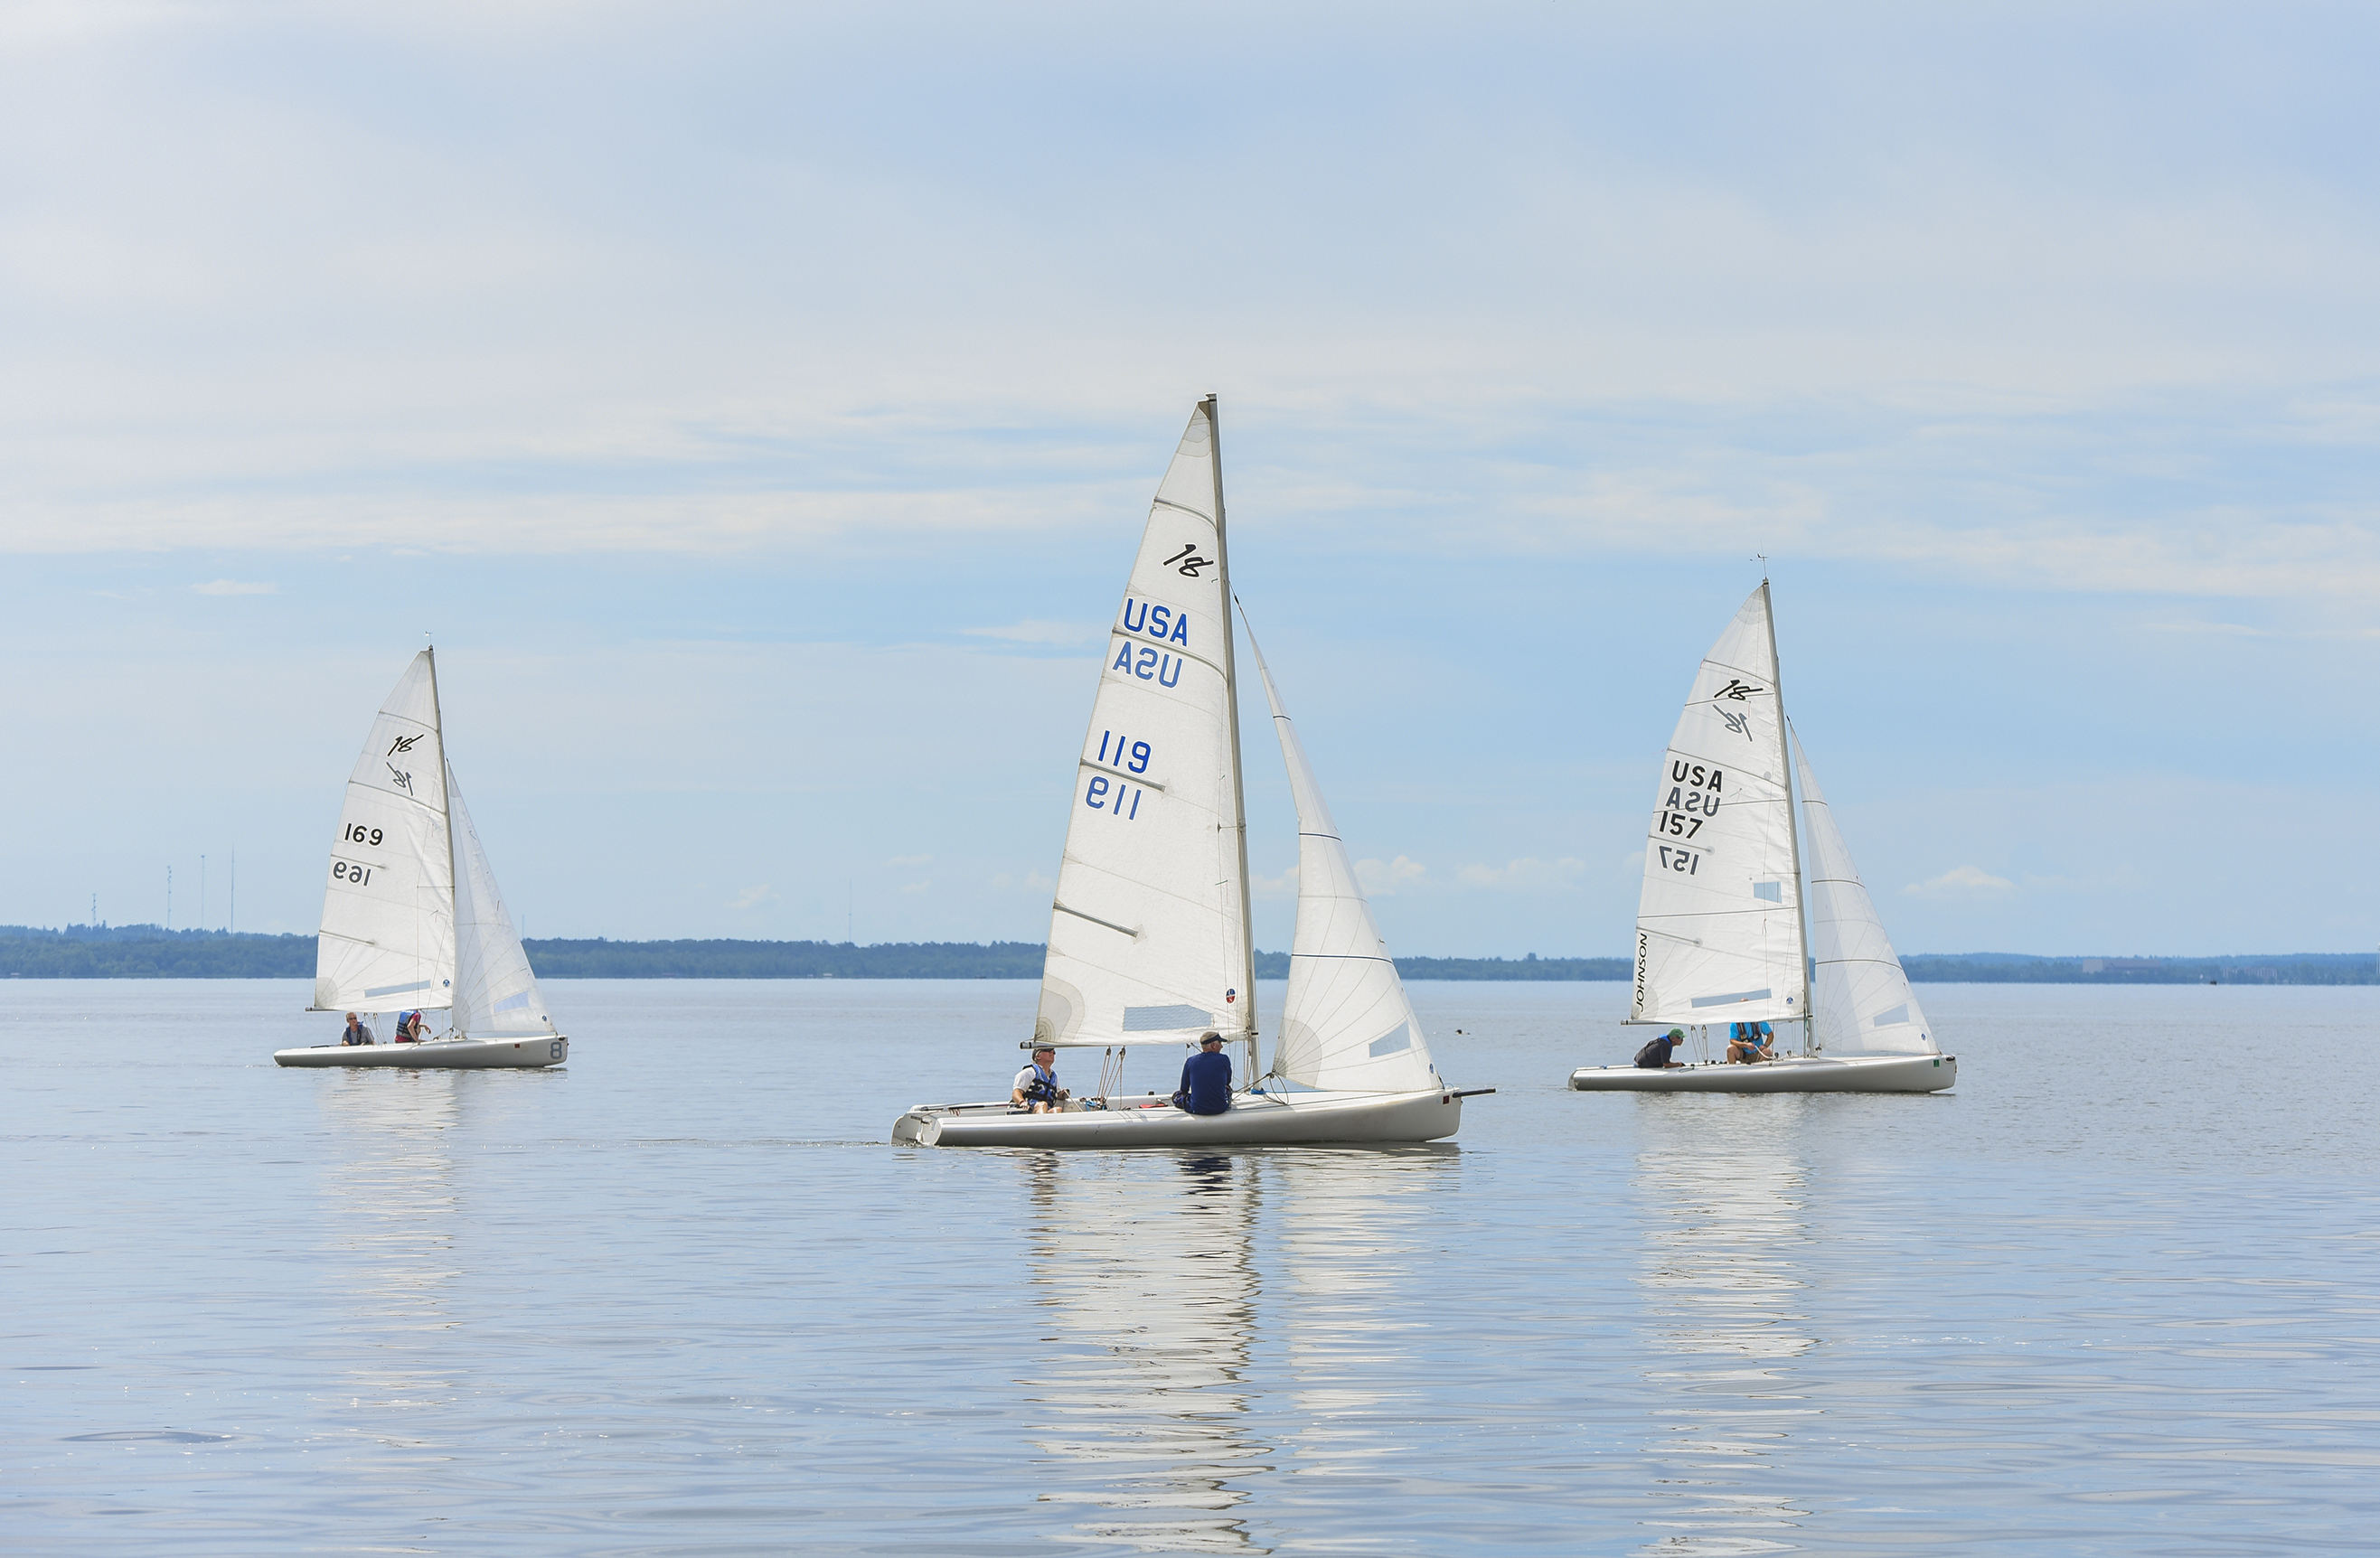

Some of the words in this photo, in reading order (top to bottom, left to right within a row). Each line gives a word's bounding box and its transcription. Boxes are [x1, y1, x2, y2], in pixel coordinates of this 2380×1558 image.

[1124, 598, 1188, 647] USA
[1097, 730, 1152, 774] 119
[1672, 760, 1722, 793] USA
[344, 823, 383, 846] 169
[1659, 811, 1703, 839] 157
[1636, 933, 1648, 1013] JOHNSON
[550, 1042, 562, 1059] 8
